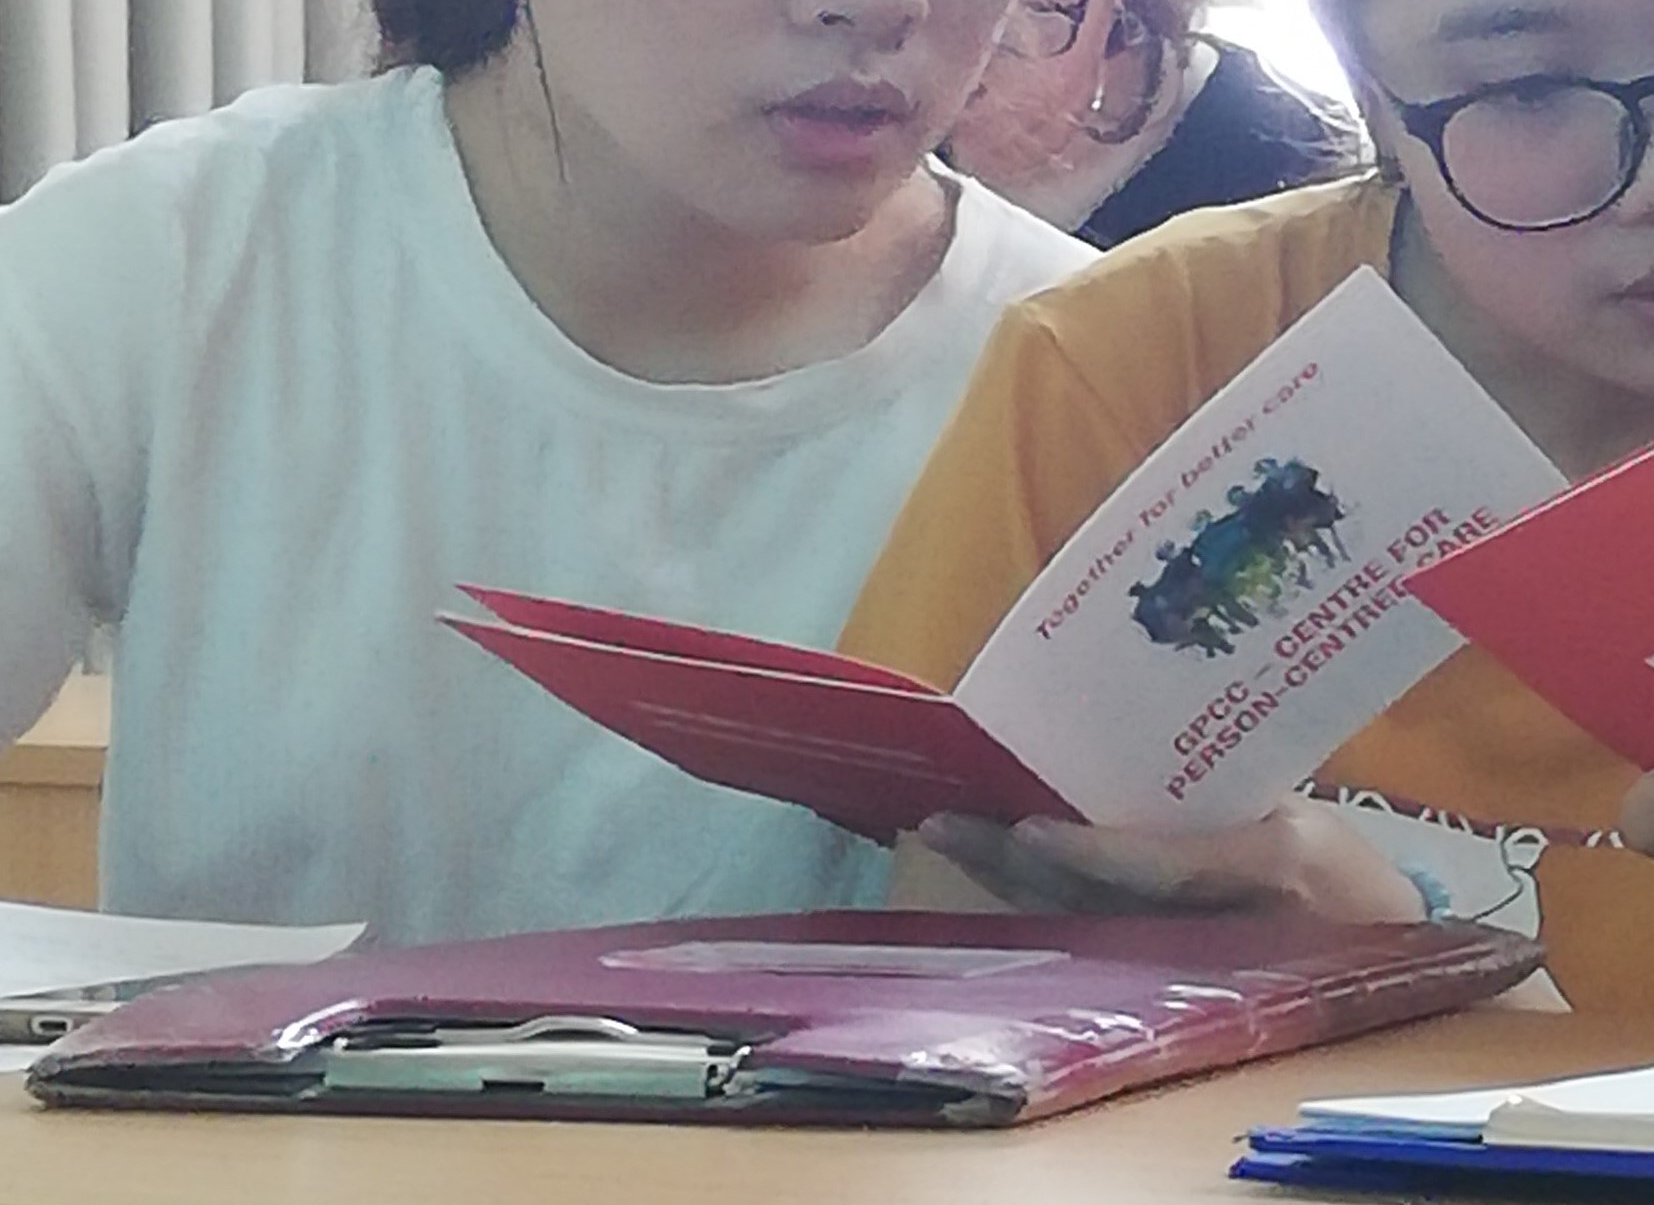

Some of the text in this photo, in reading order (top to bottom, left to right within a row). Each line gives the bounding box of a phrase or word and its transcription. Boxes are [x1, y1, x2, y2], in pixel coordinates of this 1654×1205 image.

[1036, 529, 1134, 639] Together
[1180, 416, 1257, 488] better
[1173, 681, 1249, 757] GPCC
[1274, 558, 1390, 659] CENTRE
[1387, 508, 1450, 564] FOR
